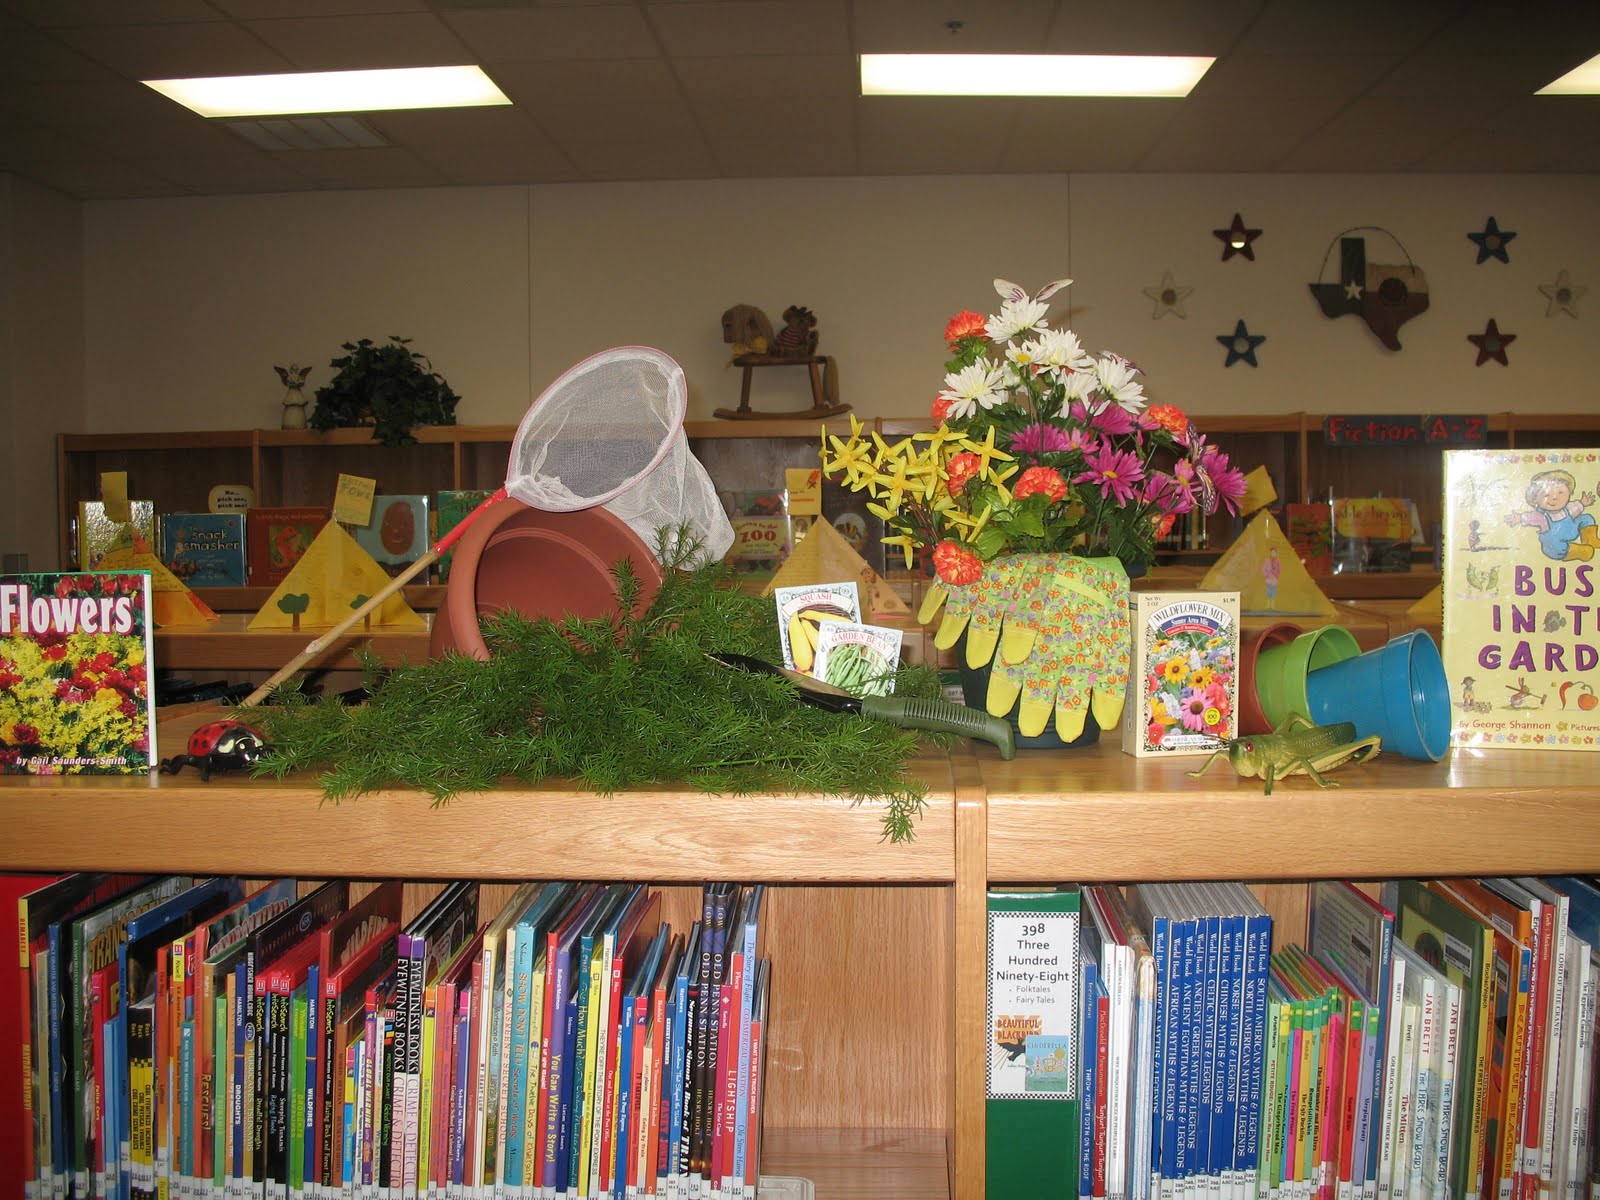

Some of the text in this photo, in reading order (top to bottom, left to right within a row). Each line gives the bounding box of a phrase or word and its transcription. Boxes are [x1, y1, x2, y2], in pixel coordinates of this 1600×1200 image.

[1328, 417, 1484, 441] Fiction A-Z
[183, 539, 240, 551] smasher
[192, 529, 228, 540] snack
[740, 530, 776, 543] ZOO
[1514, 564, 1600, 597] BUS
[0, 584, 133, 634] Flowers
[799, 592, 833, 604] SQUASH
[1153, 603, 1226, 622] WILDFLOWER MIX
[1171, 617, 1187, 626] Sunny
[1492, 604, 1536, 633] IN
[831, 631, 889, 650] GARDEN BEAN
[1459, 719, 1600, 731] By George Shannon Pictures
[16, 756, 27, 766] by
[30, 756, 49, 765] Gail
[1022, 923, 1045, 936] 398
[1559, 908, 1568, 947] Chen/Chen
[1016, 940, 1050, 950] Three
[1248, 933, 1256, 953] World
[1259, 931, 1267, 951] World
[701, 952, 710, 978] OLD
[713, 953, 722, 979] OLD
[1008, 955, 1058, 966] Hundred
[1247, 955, 1255, 974] Book
[996, 971, 1070, 984] Ninety-Eight
[1016, 985, 1051, 993] Folktales
[1482, 963, 1491, 1008] Bruchac/Vojtech
[1557, 976, 1563, 986] OF
[395, 958, 408, 1027] EYEWITNESS
[409, 961, 422, 1030] EYEWITNESS
[699, 983, 708, 1014] PENN
[711, 984, 720, 1015] PENN
[1016, 996, 1055, 1005] Fairy Tales
[1245, 979, 1254, 1013] NORTH
[1256, 978, 1265, 1011] SOUTH
[1425, 993, 1433, 1014] JAN
[1555, 988, 1563, 1004] THE
[997, 1019, 1039, 1029] BEAUTIFUL
[1450, 1002, 1458, 1024] JAN
[1099, 1010, 1107, 1045] MacDonald
[1242, 1015, 1252, 1066] AMERICAN
[1253, 1013, 1263, 1063] AMERICAN
[1422, 1019, 1431, 1054] BRETT
[394, 1032, 405, 1070] BOOKS
[408, 1034, 420, 1072] BOOKS
[697, 1018, 707, 1068] STATION
[708, 1020, 718, 1069] STATION
[1447, 1029, 1456, 1064] BRETT
[499, 1002, 512, 1146] NASREEN'S SECRET SCHOOL
[551, 1054, 561, 1070] You
[23, 1078, 32, 1110] MAYDAY!
[528, 1081, 537, 1106] Twelve
[550, 1074, 560, 1090] Can
[1240, 1068, 1249, 1102] MYTHS
[1250, 1066, 1260, 1100] MYTHS
[393, 1077, 404, 1117] CRIME
[407, 1079, 418, 1117] CRIME
[548, 1094, 559, 1121] Write
[725, 1070, 737, 1133] LIGHTSHIP
[1401, 1095, 1409, 1112] The
[392, 1119, 401, 1127] &
[527, 1109, 535, 1128] Days
[1096, 1103, 1106, 1129] Tunjur!
[1360, 1098, 1370, 1142] Sleeping Beauty
[1474, 1088, 1482, 1133] STRAWBERRIES
[406, 1120, 417, 1128] &
[1237, 1114, 1246, 1157] LEGENDS
[1247, 1111, 1257, 1153] LEGENDS
[1399, 1114, 1407, 1143] Mitten
[545, 1134, 557, 1162] Story!
[1095, 1130, 1106, 1156] Tunjur!
[1095, 1156, 1105, 1182] Tunjur!
